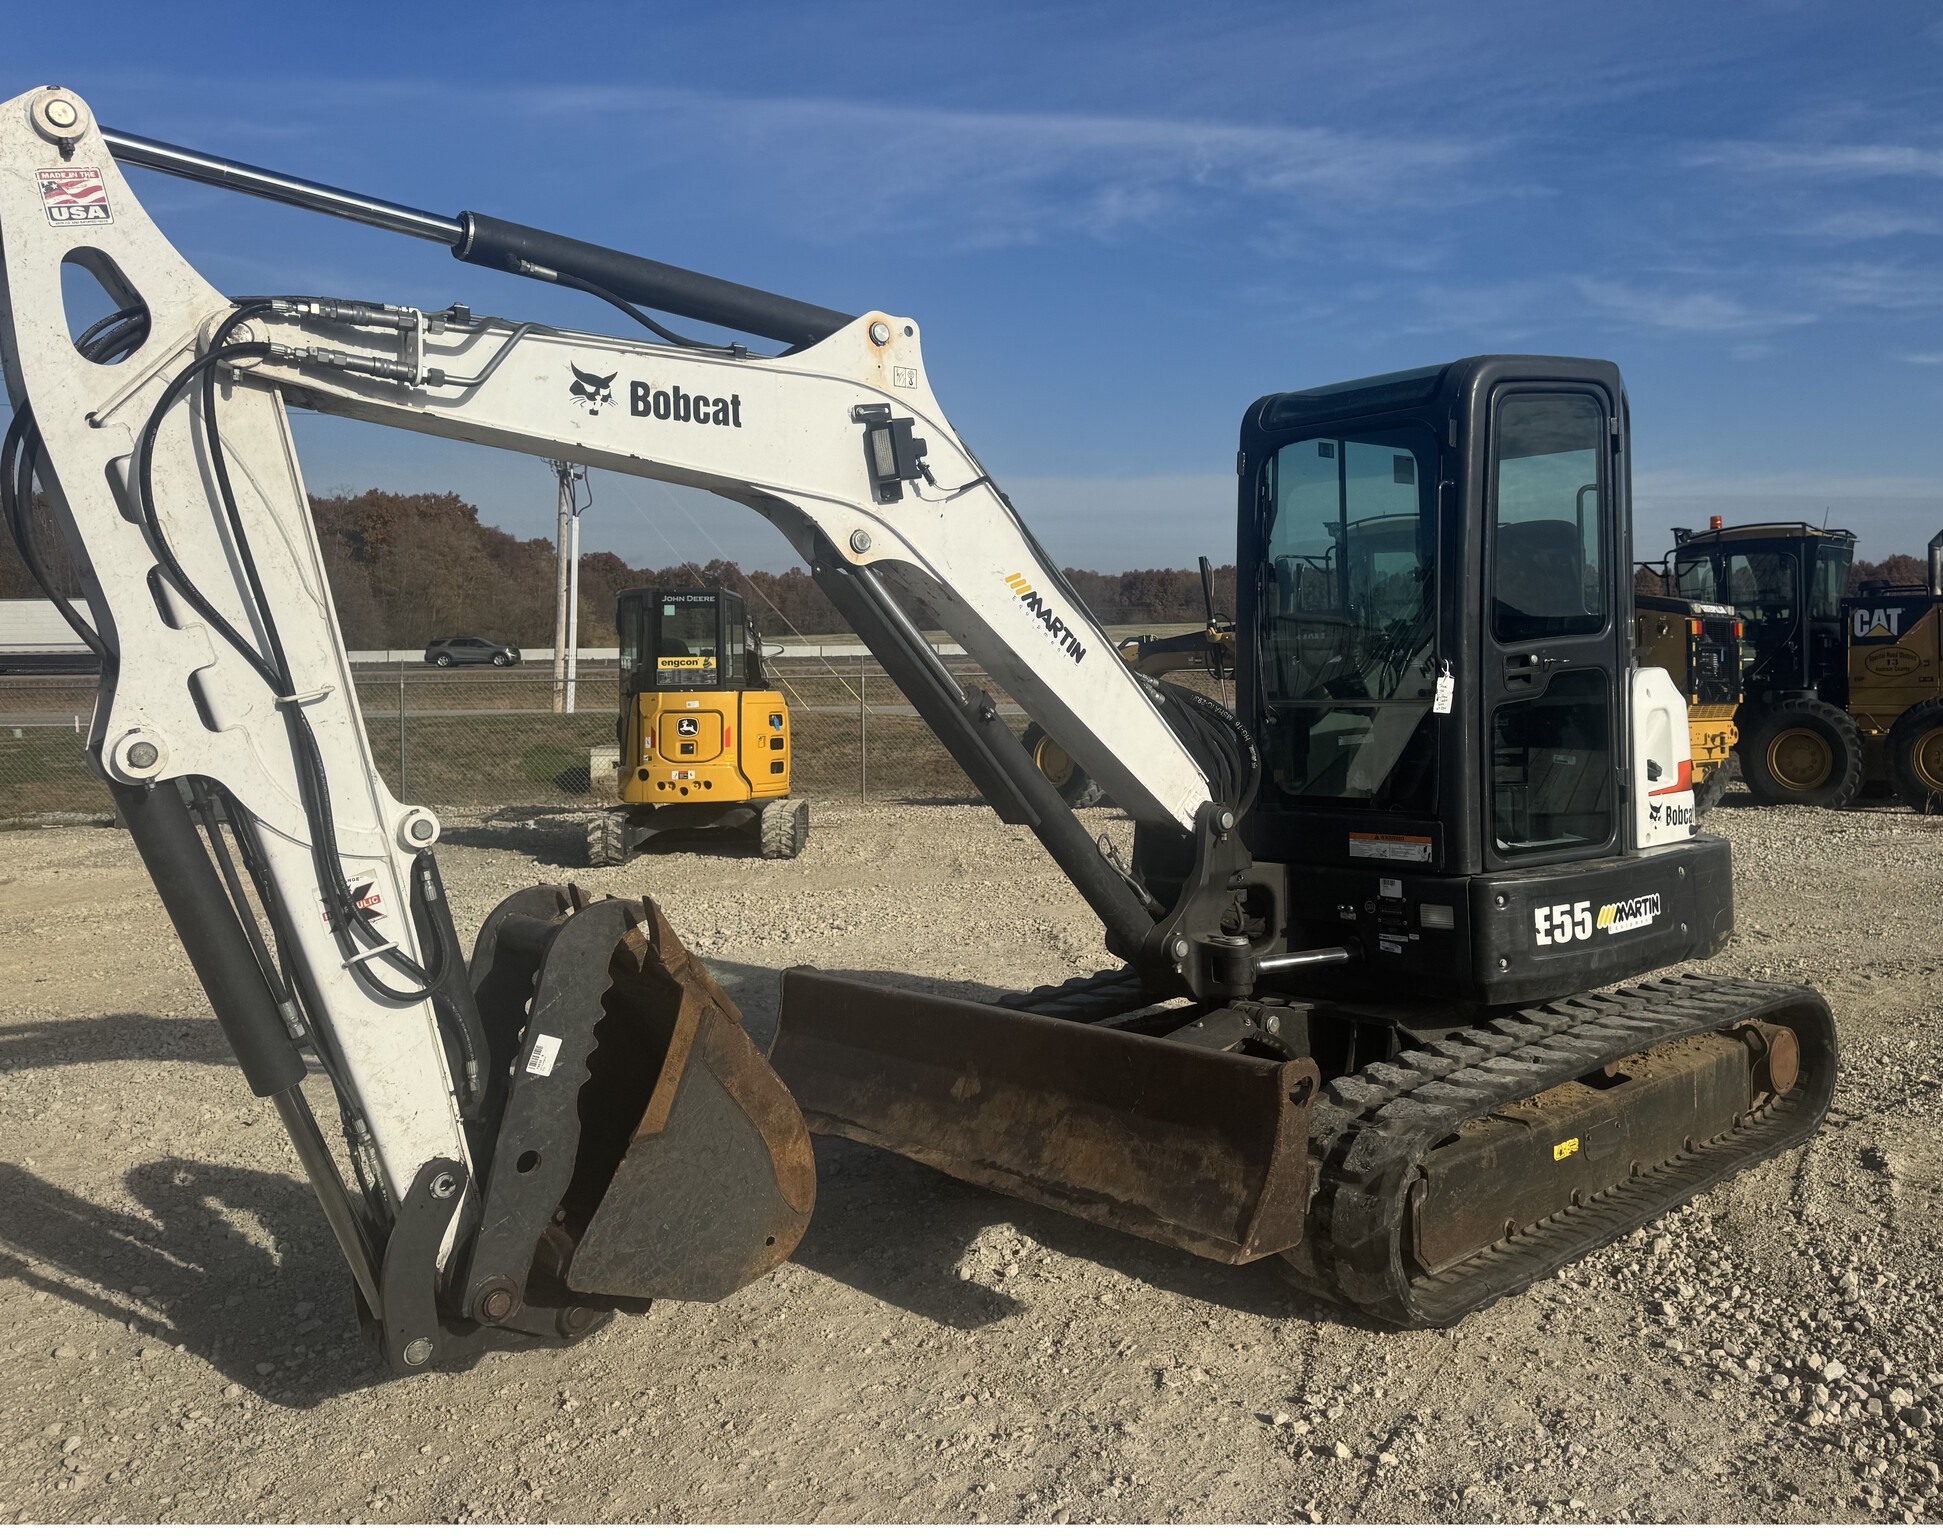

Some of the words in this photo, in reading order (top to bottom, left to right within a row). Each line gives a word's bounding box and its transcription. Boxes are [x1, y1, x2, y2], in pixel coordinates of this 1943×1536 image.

[41, 171, 65, 179] MADE
[80, 170, 95, 178] THE
[50, 205, 106, 220] USA
[630, 380, 742, 428] Bobcat
[1021, 590, 1087, 664] MARTIN
[1853, 607, 1902, 637] CAT
[661, 659, 698, 667] engcon
[1535, 901, 1593, 946] E55
[1613, 895, 1660, 924] MARTIN
